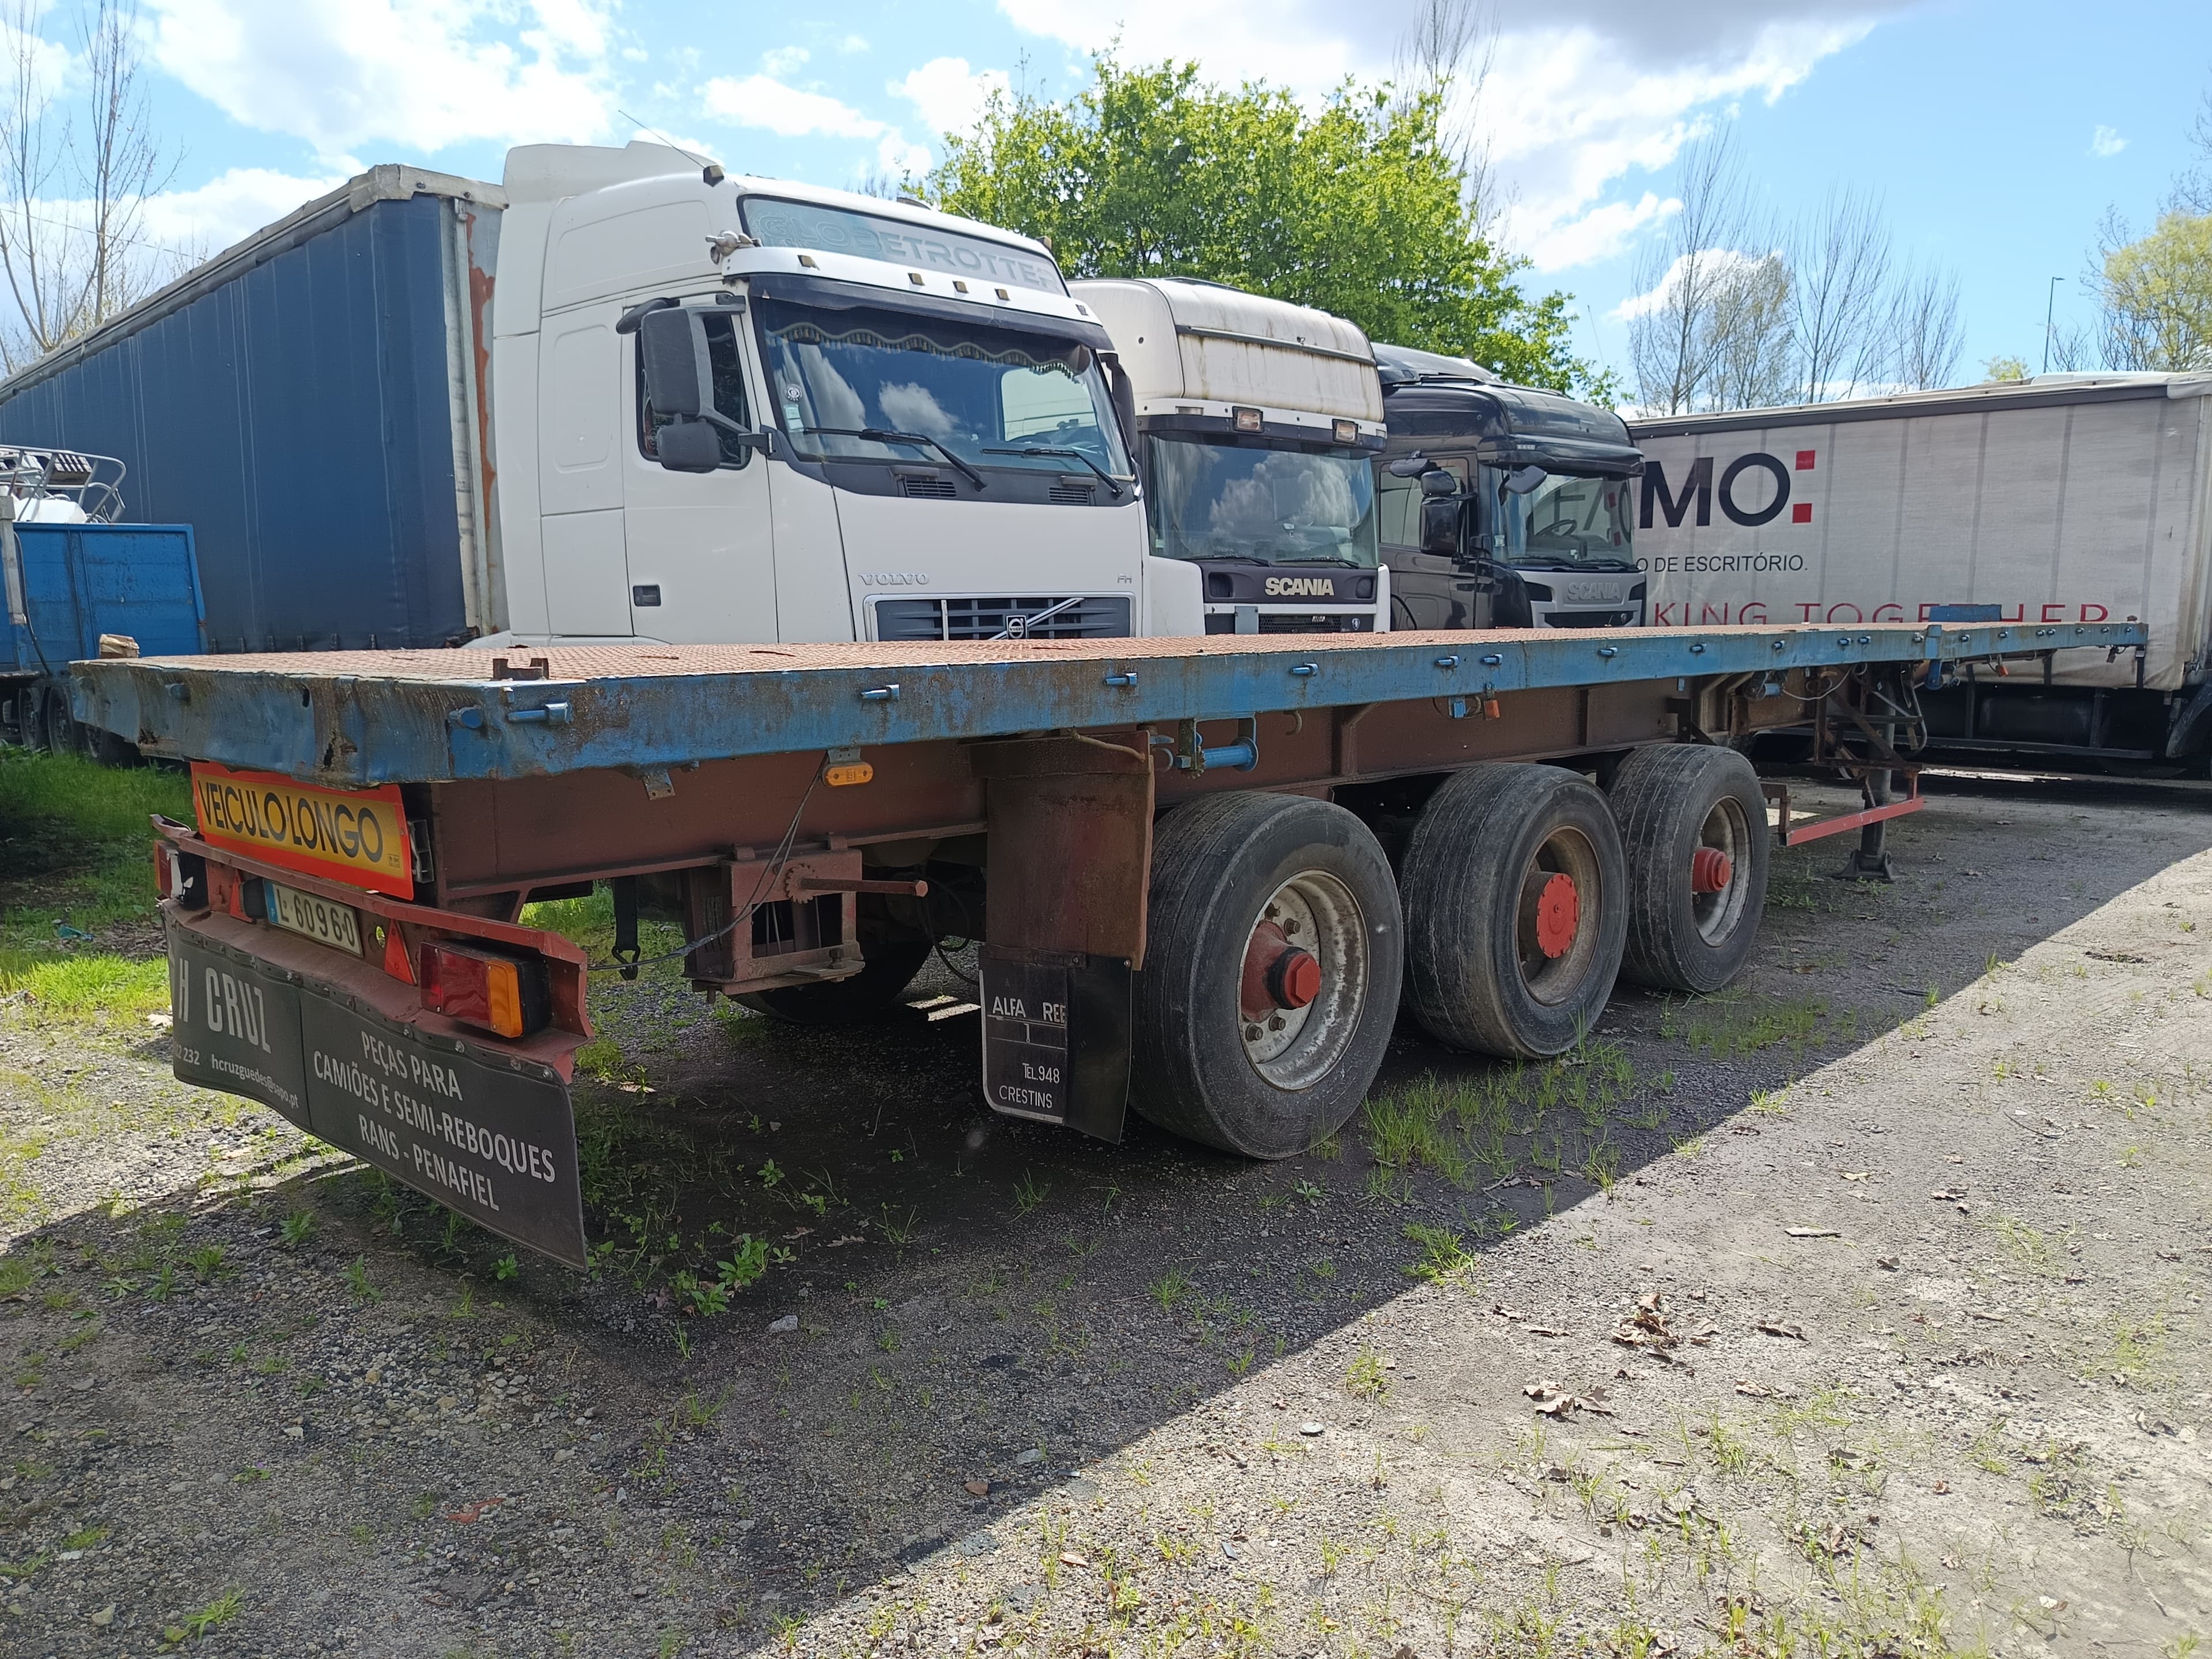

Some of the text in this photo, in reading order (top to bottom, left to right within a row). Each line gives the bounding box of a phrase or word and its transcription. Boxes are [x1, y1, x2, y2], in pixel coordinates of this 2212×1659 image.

[758, 215, 1062, 294] GLOBETROTTER
[858, 573, 930, 585] VOLVO
[1264, 577, 1335, 596] SCANIA
[1567, 581, 1622, 601] SCANIA
[1655, 558, 1677, 572] DE
[1685, 552, 1808, 571] ESCRITÓRIO.
[198, 780, 383, 863] VEICULO LONGO
[206, 967, 271, 1054] CRUZ
[992, 996, 1026, 1018] ALFA
[183, 1047, 200, 1065] 232
[211, 1054, 299, 1108] hcruzguedes@sapo.pt
[361, 1031, 463, 1101] PEÇAS PARA
[313, 1051, 556, 1183] CAMIÕES E SEMI-REBOQUES
[999, 1085, 1053, 1109] CRESTINS
[358, 1113, 400, 1160] RANS
[412, 1143, 499, 1211] PENAFIEL
